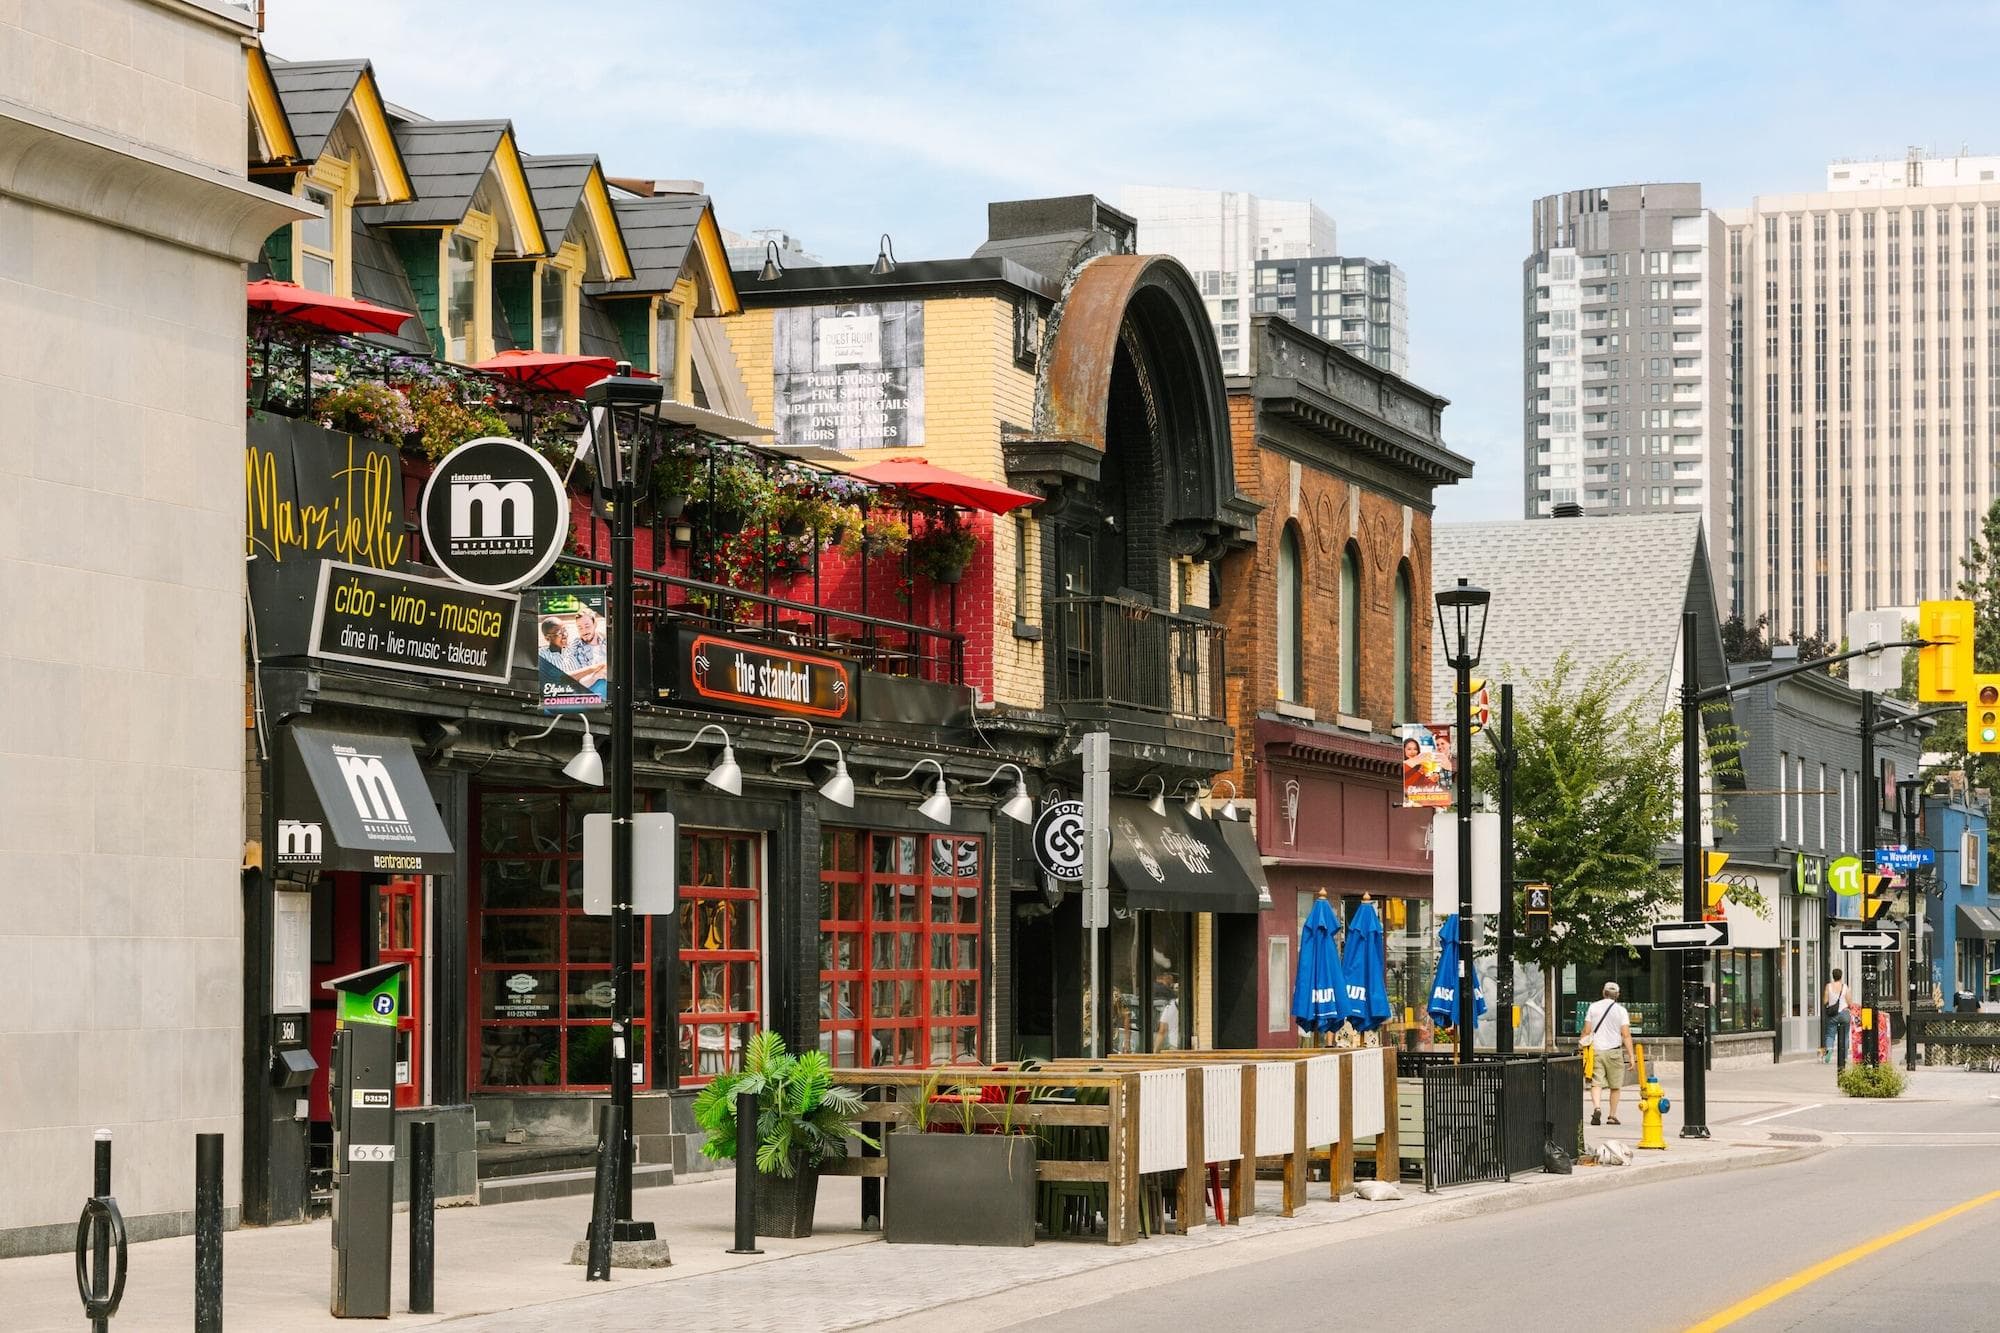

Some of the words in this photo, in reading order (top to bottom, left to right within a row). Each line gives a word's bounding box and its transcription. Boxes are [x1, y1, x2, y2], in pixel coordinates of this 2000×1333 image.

[807, 373, 874, 387] PURVEYORS
[878, 372, 893, 384] OF
[812, 388, 837, 400] FINE
[787, 402, 844, 416] UPLIFTING
[812, 415, 862, 427] OYSTERS
[865, 414, 888, 425] AND
[803, 429, 835, 440] HORS
[451, 473, 492, 481] ristorante
[451, 481, 534, 537] m
[451, 540, 534, 549] marzitelli
[335, 577, 376, 617] cibo
[390, 586, 427, 626] vino
[439, 600, 502, 638] musica
[340, 624, 366, 649] dine
[367, 628, 379, 651] in
[387, 631, 405, 654] live
[406, 637, 440, 660] music
[447, 642, 488, 667] takeout
[735, 652, 755, 695] the
[759, 659, 811, 704] standard
[544, 683, 565, 697] Elgin
[544, 696, 602, 705] CONNECTION
[336, 756, 408, 820] m
[1055, 804, 1083, 817] SOLE
[278, 824, 322, 854] m
[380, 854, 416, 869] entrance
[1890, 852, 1921, 864] Waverley
[282, 1022, 295, 1040] 360
